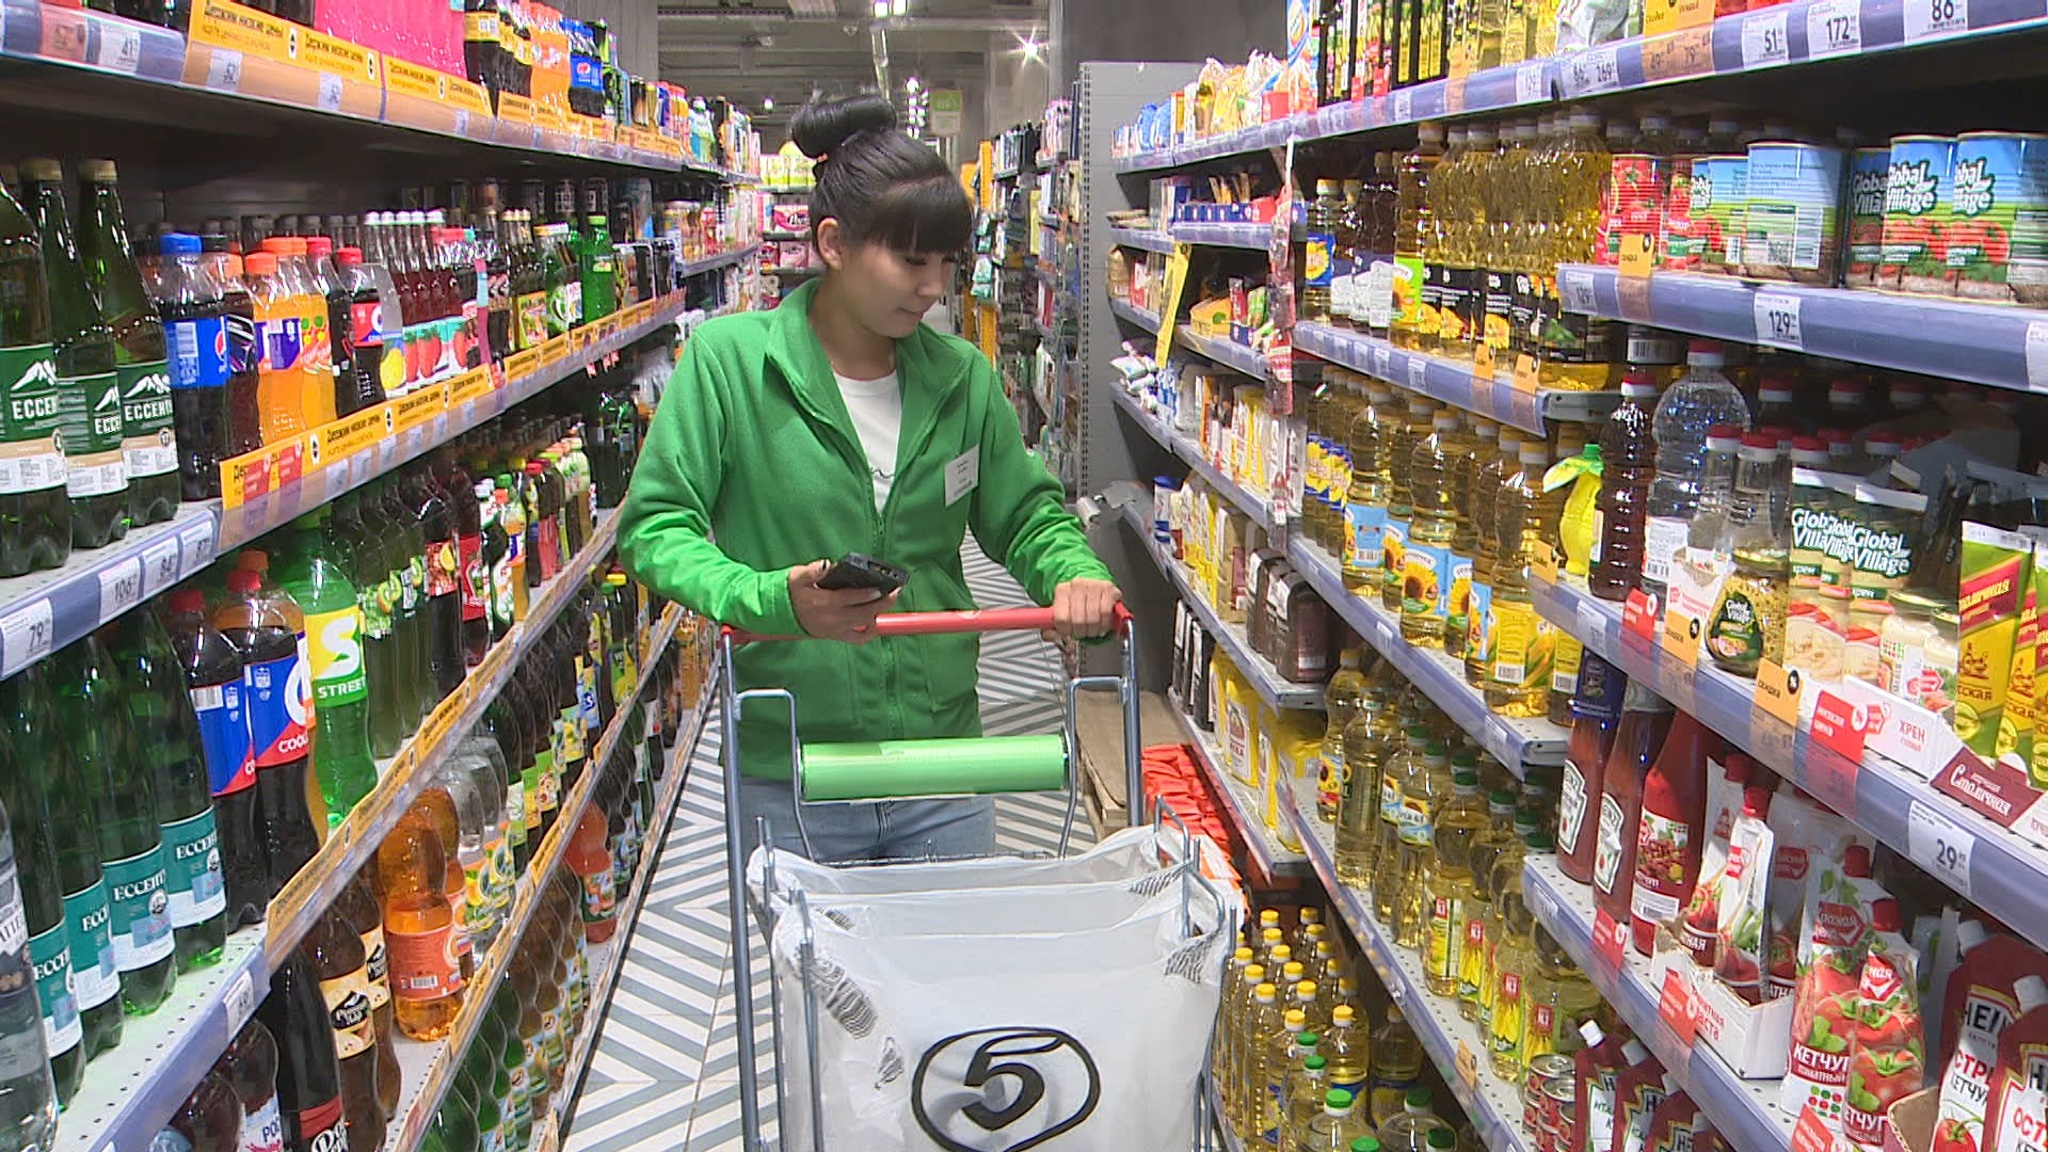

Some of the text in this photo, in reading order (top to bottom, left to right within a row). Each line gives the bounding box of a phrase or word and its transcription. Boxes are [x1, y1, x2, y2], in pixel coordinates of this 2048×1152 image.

[1763, 28, 1778, 52] 51
[1826, 16, 1850, 42] 172
[1768, 310, 1790, 334] 129
[1853, 526, 1904, 553] Global
[1853, 547, 1911, 577] Village
[27, 624, 45, 650] 79
[1901, 720, 1925, 742] ХРЕН
[1936, 838, 1958, 870] 29
[961, 1031, 1065, 1133] 5
